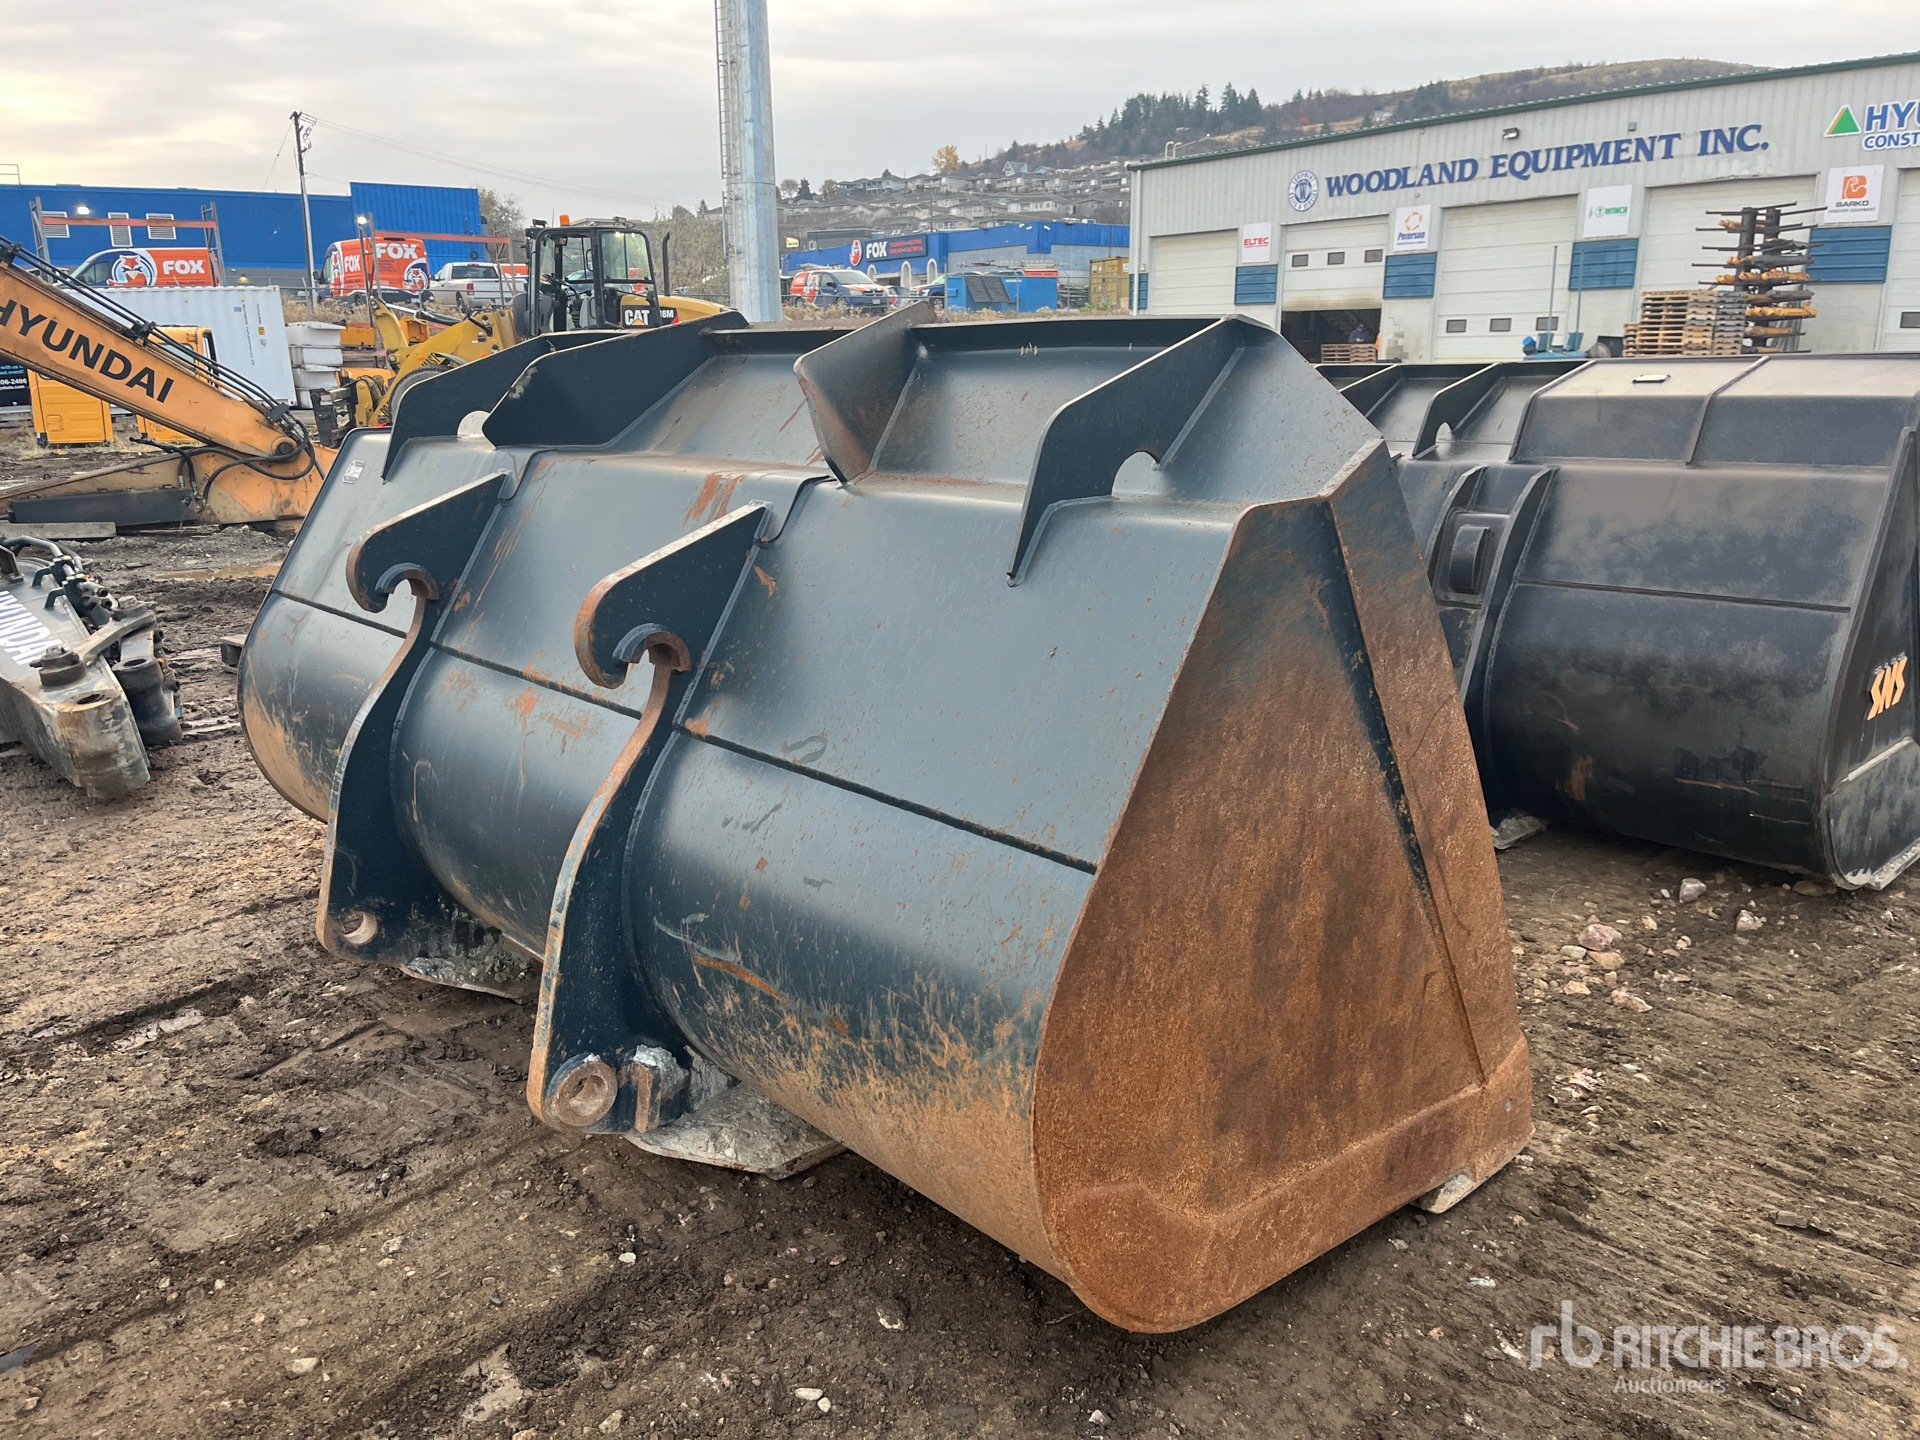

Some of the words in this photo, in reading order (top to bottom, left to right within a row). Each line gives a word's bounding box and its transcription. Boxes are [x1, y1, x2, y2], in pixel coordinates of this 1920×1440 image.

[1865, 101, 1920, 132] HY
[1326, 157, 1479, 198] WOODLAND
[1488, 132, 1682, 181] EQUIPMENT
[1696, 124, 1770, 156] INC.
[1835, 200, 1870, 208] BARKO
[1243, 236, 1269, 246] ELTEC
[375, 242, 418, 259] FOX
[866, 241, 888, 259] FOX
[162, 259, 206, 275] FOX
[344, 254, 361, 273] FOX
[624, 309, 650, 326] CAT
